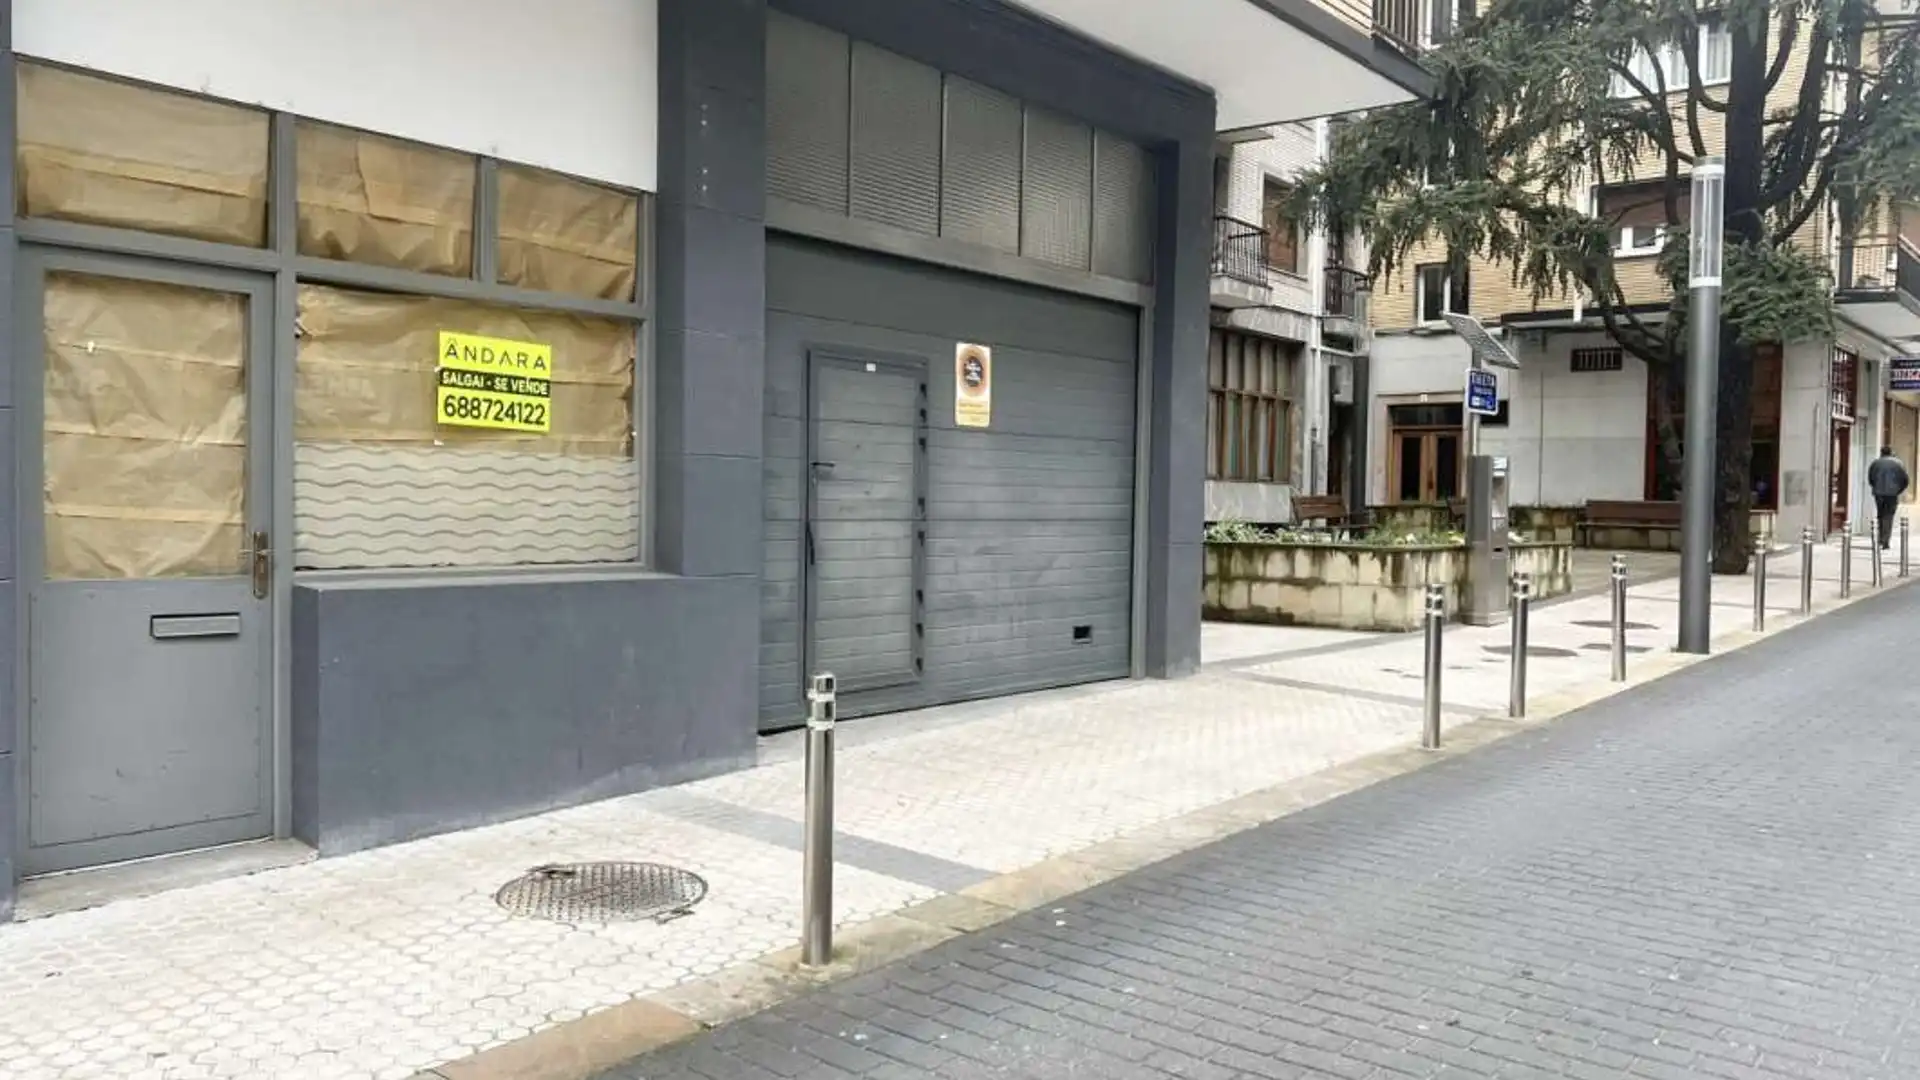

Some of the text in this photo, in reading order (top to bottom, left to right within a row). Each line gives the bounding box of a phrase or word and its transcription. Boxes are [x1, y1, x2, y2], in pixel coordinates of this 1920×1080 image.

[442, 371, 548, 395] SALGAI SE VENDE
[443, 394, 546, 426] 688724122
